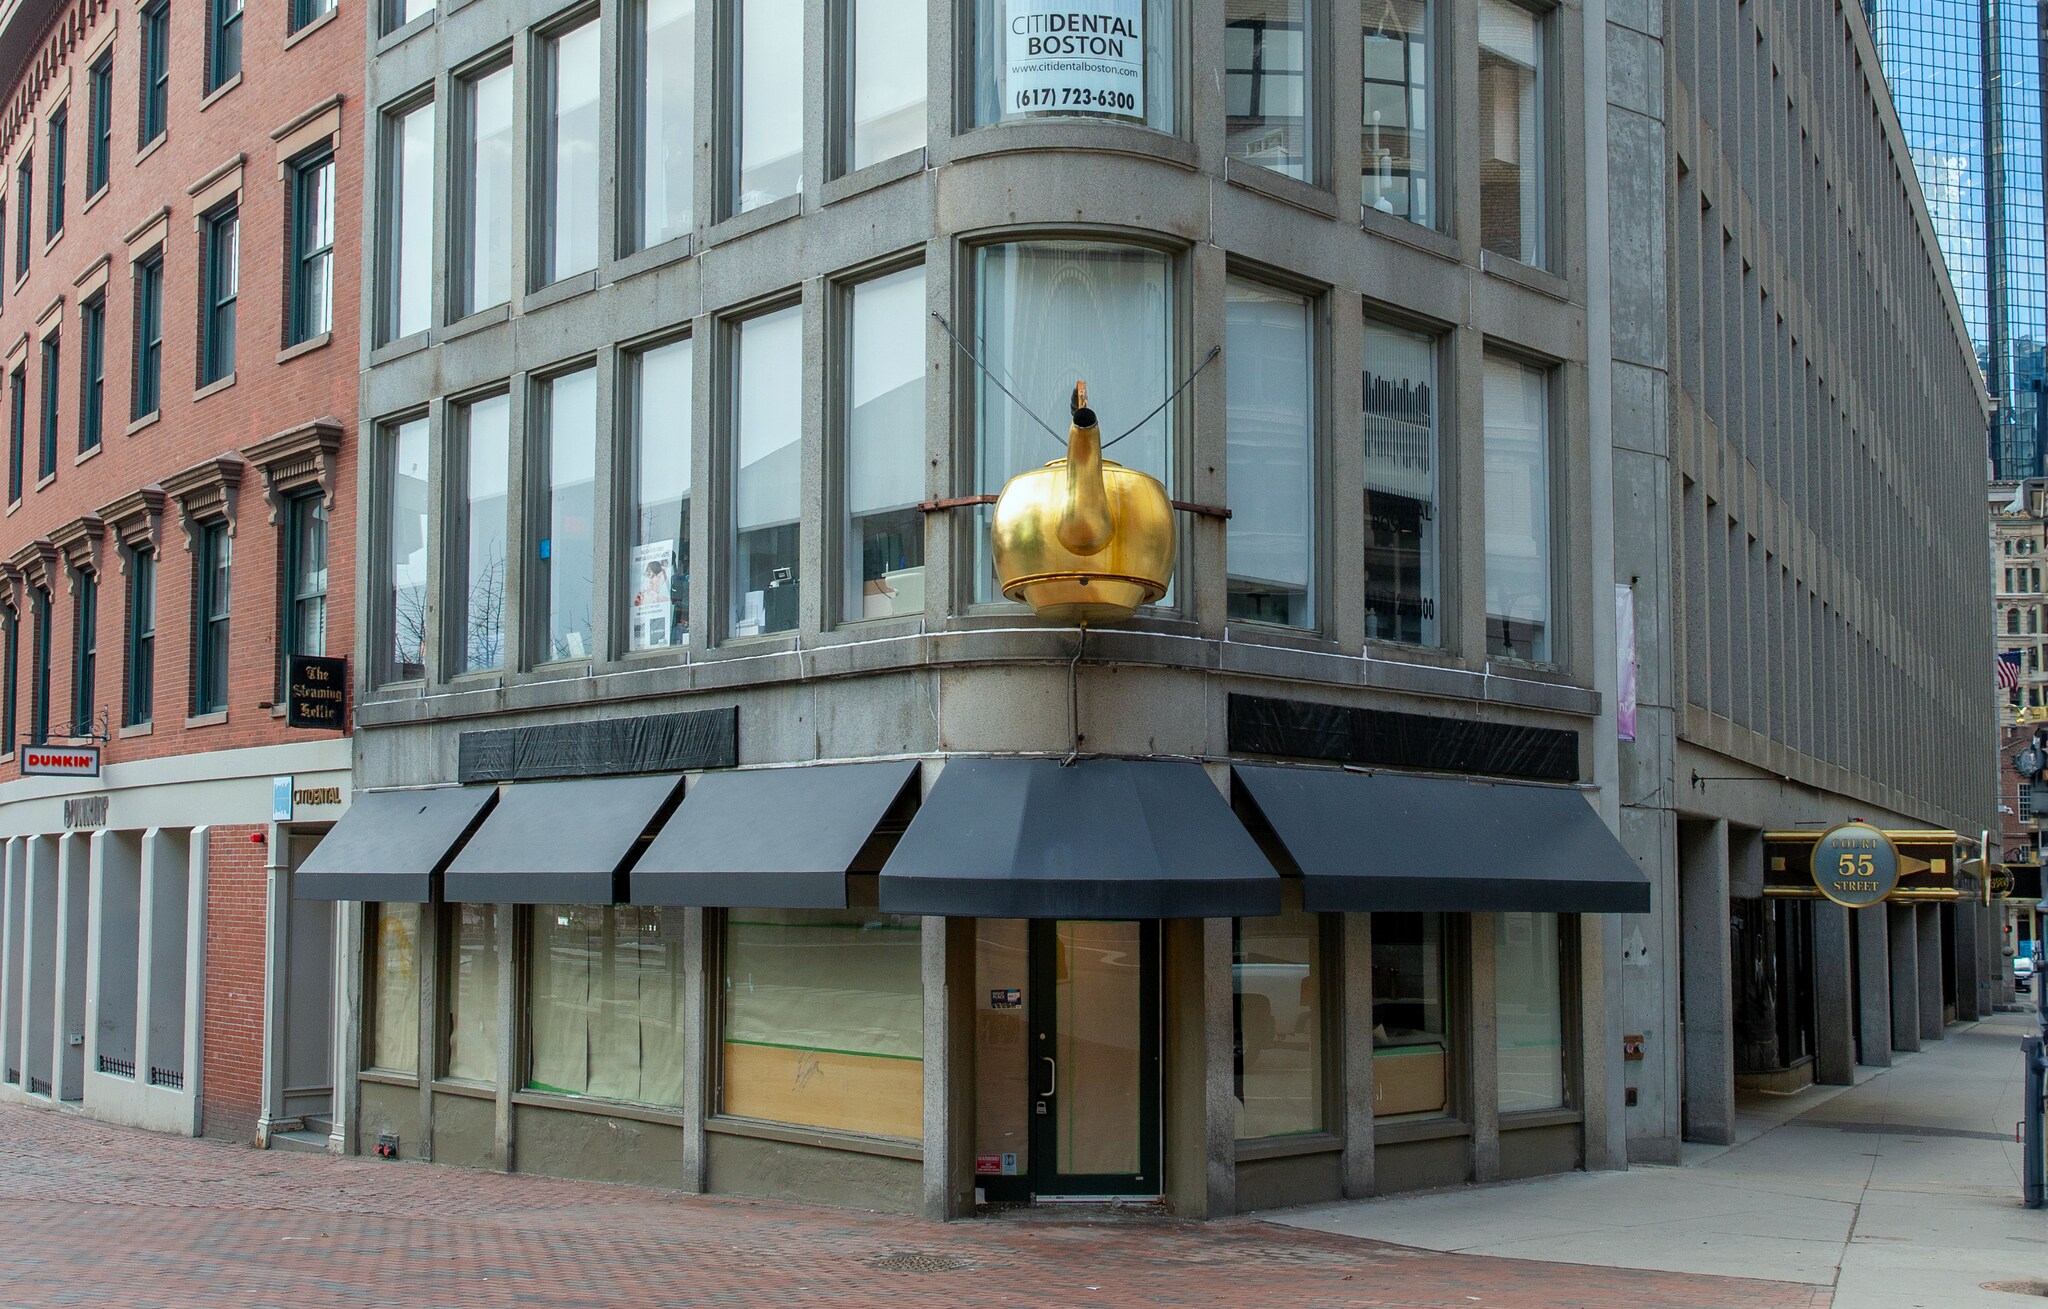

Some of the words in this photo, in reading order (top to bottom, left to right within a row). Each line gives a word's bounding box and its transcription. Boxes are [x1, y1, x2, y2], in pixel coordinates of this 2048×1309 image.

[1012, 13, 1138, 39] CITIDENTAL
[1028, 35, 1123, 58] BOSTON
[1012, 61, 1138, 78] www.citidentalboston.com
[1016, 88, 1056, 109] (617)
[1062, 88, 1135, 110] 723-6300
[305, 665, 330, 680] The
[292, 684, 342, 703] Steaming
[300, 702, 336, 719] Kettle
[28, 754, 93, 768] DUNKIN'
[294, 787, 341, 805] CITIDENTAL
[1831, 838, 1878, 849] COURT
[1838, 853, 1875, 876] 55
[1832, 880, 1880, 892] STREET
